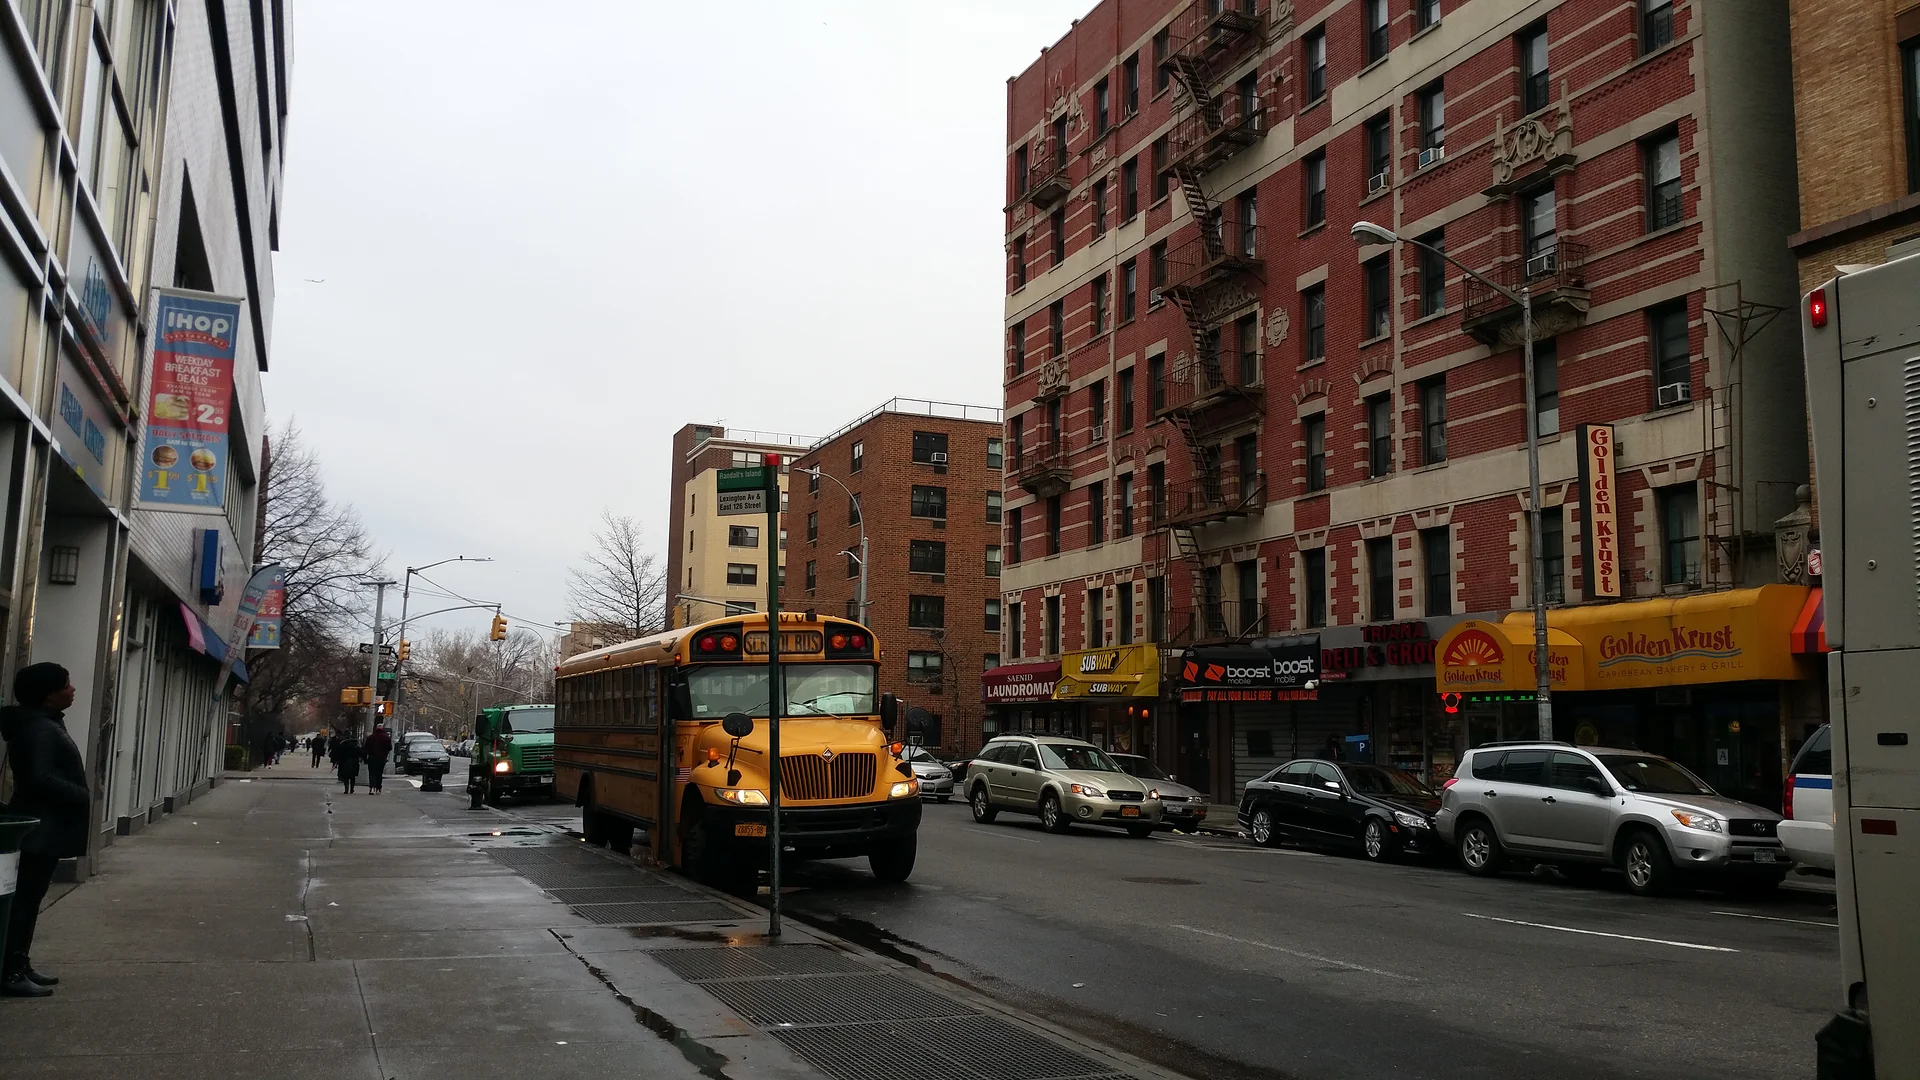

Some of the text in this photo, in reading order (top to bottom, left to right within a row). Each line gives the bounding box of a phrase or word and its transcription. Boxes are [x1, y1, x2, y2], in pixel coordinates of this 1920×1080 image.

[168, 311, 229, 338] IHOP
[174, 354, 214, 367] WEEKDAY
[164, 362, 222, 378] BREAKFAST
[176, 373, 208, 386] DEALS
[180, 431, 222, 442] SPECIALS
[720, 470, 762, 480] Randall's Island
[720, 494, 746, 502] Lexington
[1590, 428, 1613, 593] Golden Krust
[1362, 622, 1425, 642] TRIANA
[746, 634, 820, 652] SCHOL BUS
[1600, 624, 1735, 660] Golden Krust
[1080, 652, 1117, 672] SUBWAY
[1273, 656, 1314, 675] boost
[1322, 648, 1360, 670] DELI
[1366, 646, 1381, 667] &
[1528, 650, 1569, 666] Gden
[1226, 665, 1270, 678] boost
[1444, 668, 1502, 683] Golden Krust
[1534, 666, 1568, 681] ust
[1598, 660, 1744, 679] CARIBBEAN BAKERY & GRILL
[1006, 674, 1033, 682] SAENID
[1274, 676, 1296, 684] mobile
[987, 682, 1054, 698] LAUNDROMAT
[1089, 682, 1128, 693] SUBWAY
[1207, 691, 1217, 701] PAY
[1217, 691, 1227, 700] ALL
[1228, 691, 1241, 700] YOUR
[1242, 691, 1257, 700] BILLS
[1258, 690, 1272, 700] HERE
[1359, 742, 1366, 752] P
[1719, 750, 1726, 760] A
